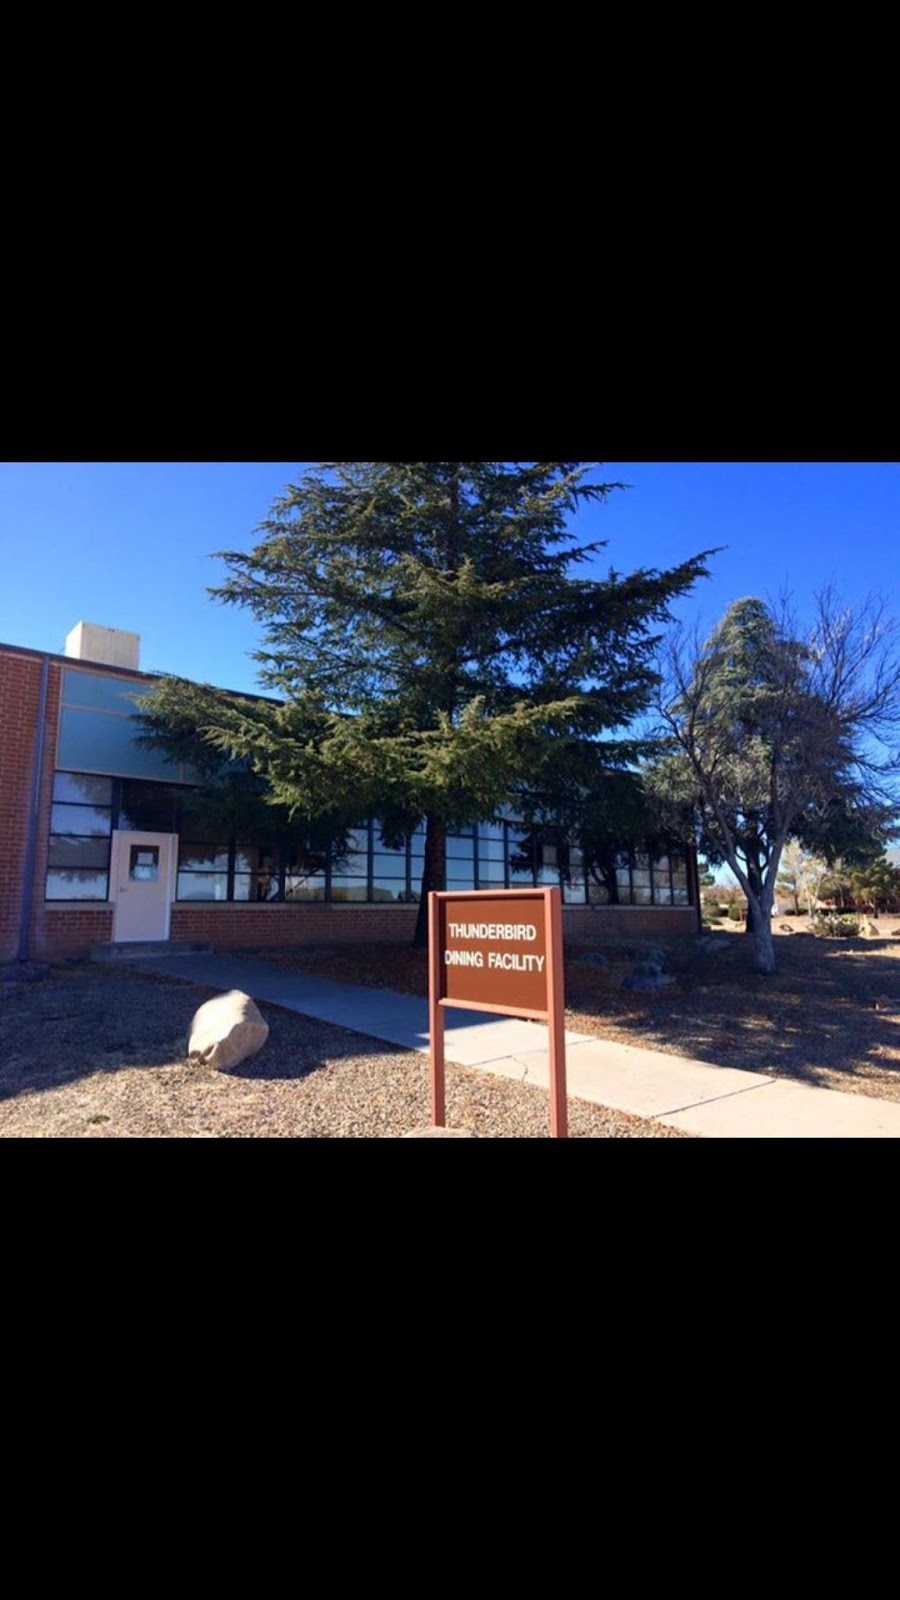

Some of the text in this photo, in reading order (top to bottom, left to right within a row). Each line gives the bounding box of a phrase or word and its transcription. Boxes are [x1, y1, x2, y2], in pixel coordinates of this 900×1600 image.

[448, 923, 537, 941] THUNDERBIRD
[444, 950, 545, 972] DINING FACILITY
